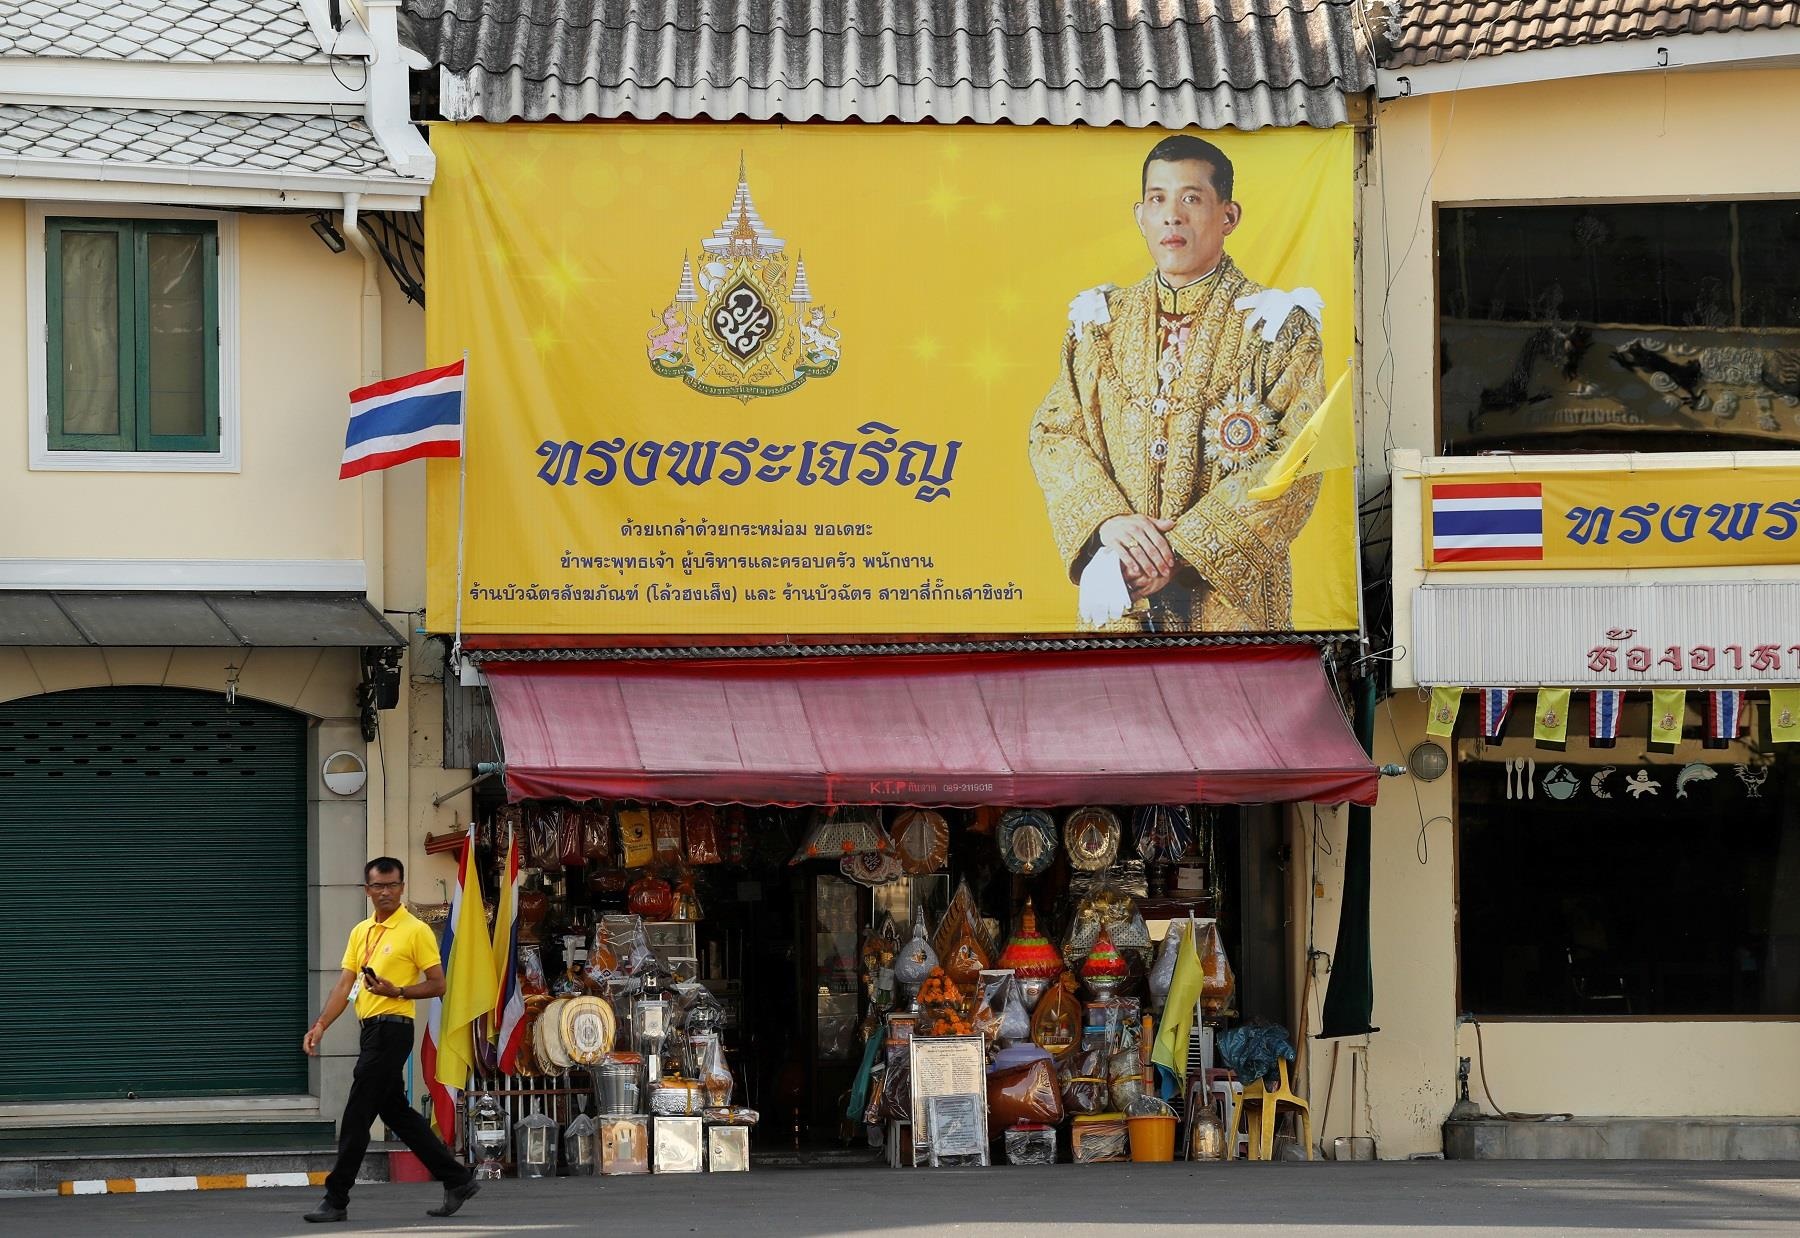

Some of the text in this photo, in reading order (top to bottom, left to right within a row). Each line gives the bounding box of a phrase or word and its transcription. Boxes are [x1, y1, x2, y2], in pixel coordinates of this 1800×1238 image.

[535, 421, 963, 503] ทรงพระเจริญ
[620, 517, 873, 537] ด้วยเกล้าด้วยกระหม่อม ขอเดชะ
[560, 549, 934, 576] ข้าพระพุทธเจ้า ผู้บริหารและครอบครัว พนักงาน
[469, 578, 1023, 603] ร้านบัวฉัตรสังฆภัณฑ์ (โล้วฮงเส็ง) และ ร้านบัวฉัตร สาขาสี่กั๊กเสาชิงช้า
